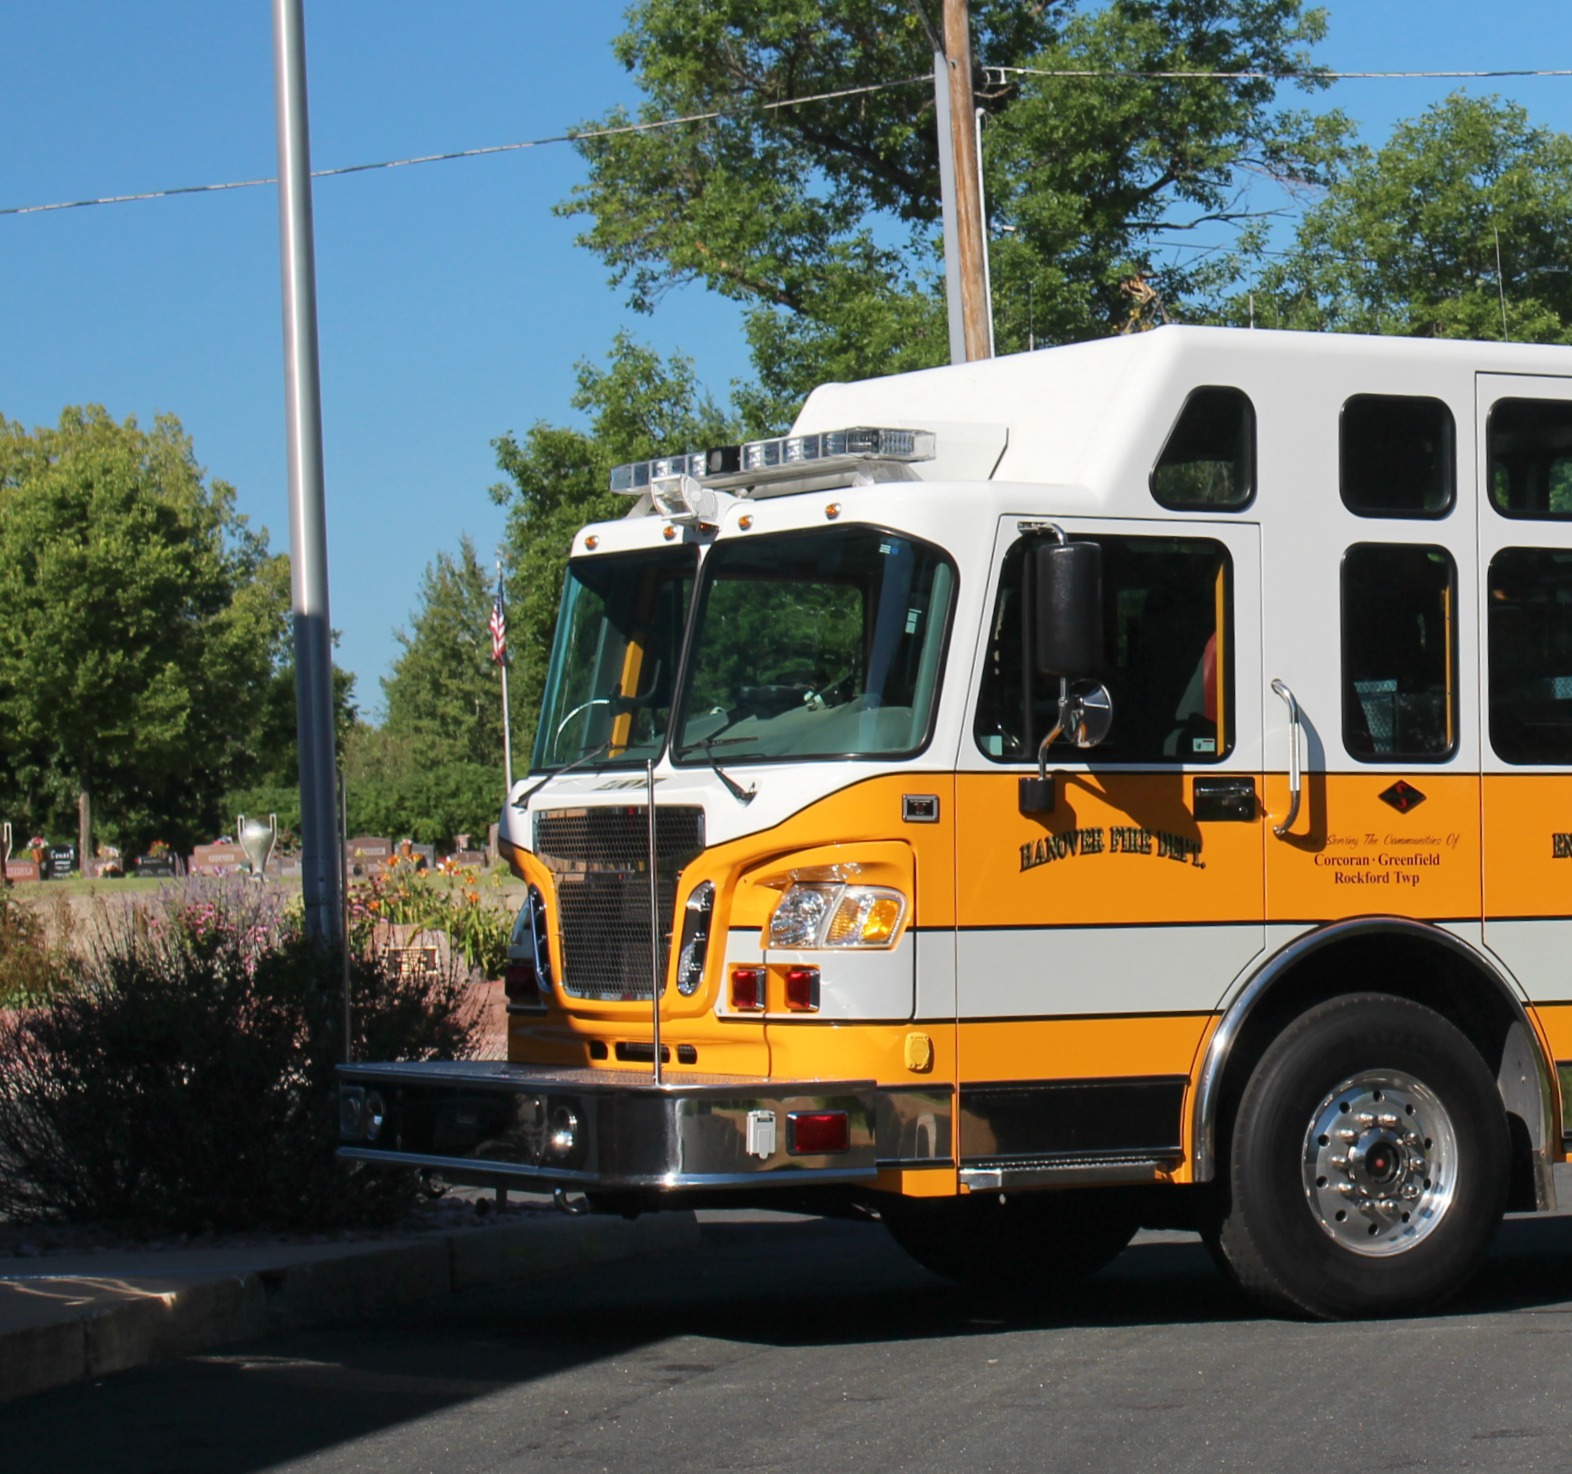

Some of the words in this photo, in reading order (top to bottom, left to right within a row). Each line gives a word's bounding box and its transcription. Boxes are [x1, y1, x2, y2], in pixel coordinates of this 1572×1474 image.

[1019, 827, 1105, 873] HANOVER
[1110, 826, 1153, 855] FIRE
[1156, 830, 1207, 870] DEPT.
[1363, 833, 1379, 846] The
[1383, 833, 1442, 847] Communities
[1445, 832, 1461, 850] Of
[1314, 852, 1370, 867] Corcoran
[1378, 852, 1440, 867] Greenfield
[1334, 871, 1390, 885] Rockford
[1393, 870, 1420, 887] Twp
